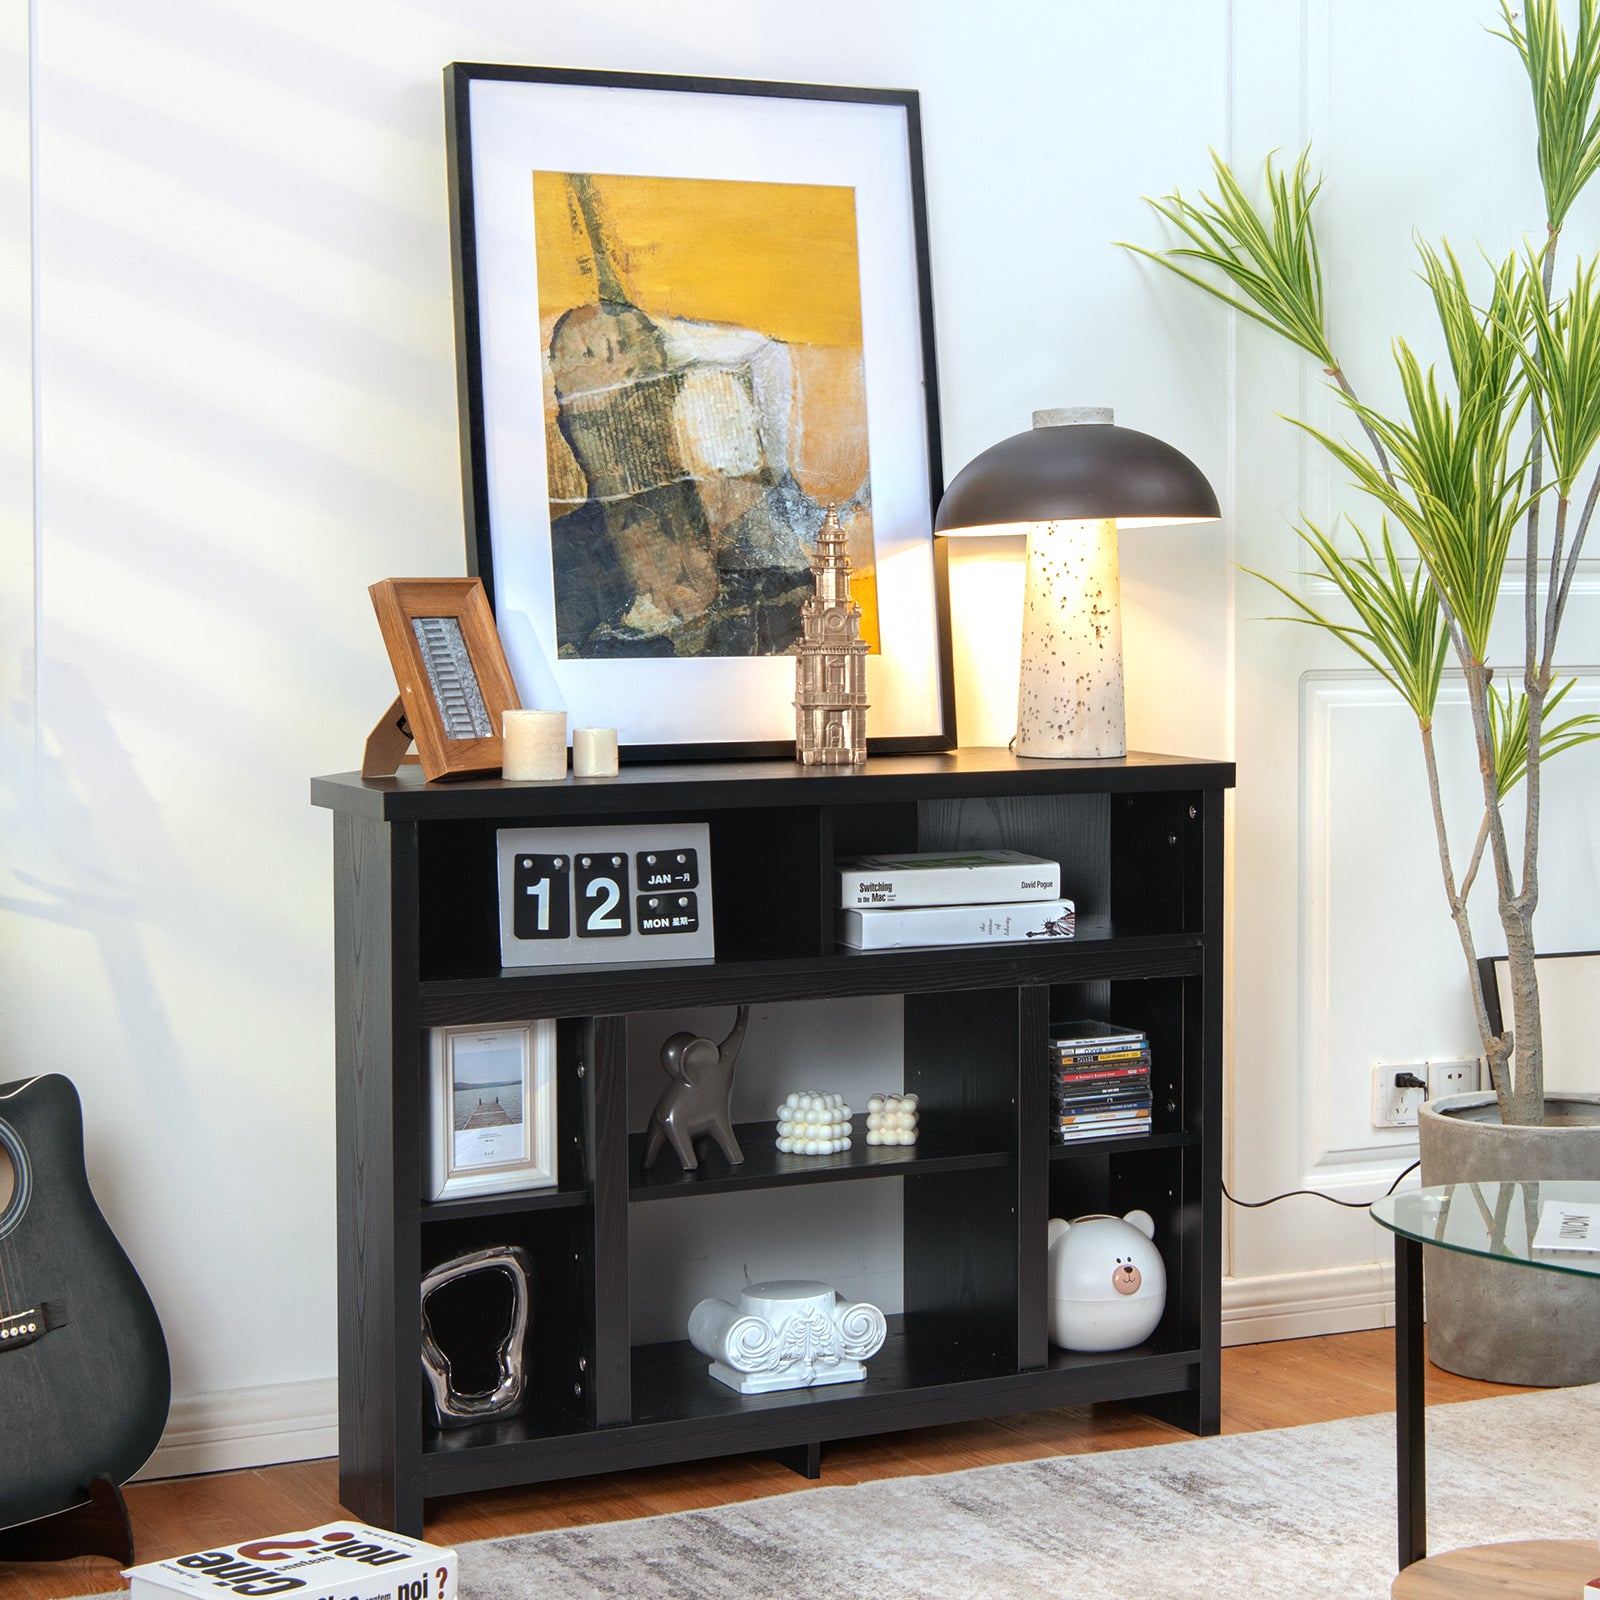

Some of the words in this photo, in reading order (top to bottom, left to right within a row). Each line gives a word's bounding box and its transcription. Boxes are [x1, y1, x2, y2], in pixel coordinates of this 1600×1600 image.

[648, 874, 672, 885] JAN
[675, 873, 690, 882] 一月
[1021, 881, 1036, 889] David
[1036, 880, 1054, 889] Pogue
[859, 882, 893, 893] Switching
[871, 892, 886, 902] Mac
[643, 918, 670, 929] MON
[306, 1539, 412, 1567] noi
[176, 1552, 307, 1597] Cine
